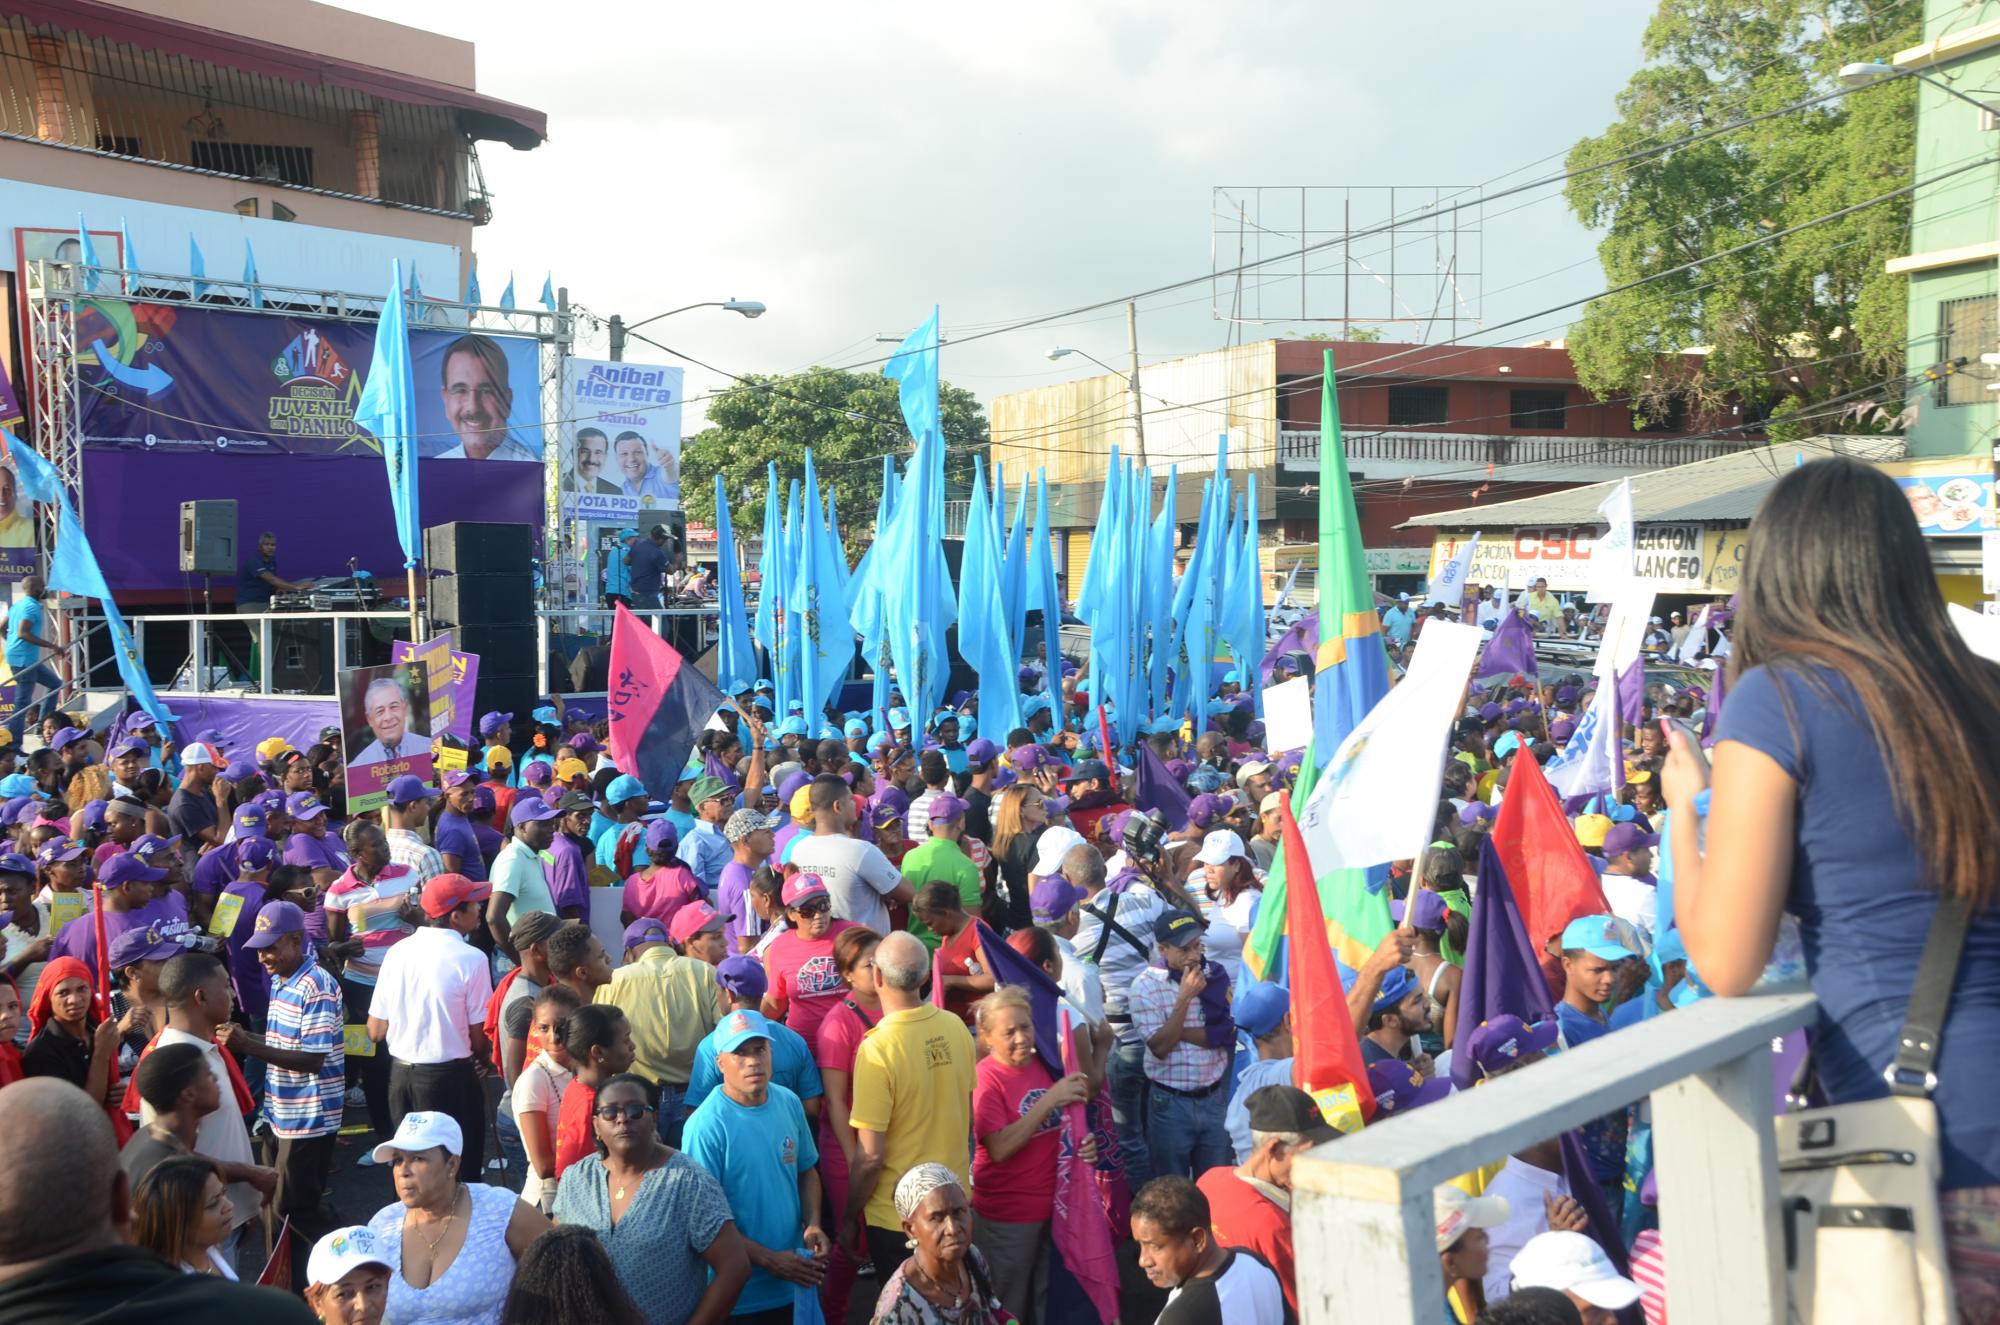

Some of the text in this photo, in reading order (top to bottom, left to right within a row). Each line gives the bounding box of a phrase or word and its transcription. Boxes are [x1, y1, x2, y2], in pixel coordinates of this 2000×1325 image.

[588, 365, 664, 387] Aníbal
[291, 386, 336, 398] DECISIÓN
[576, 380, 671, 403] Herrera
[269, 397, 353, 419] JUVENIL
[287, 416, 357, 436] DANILO
[596, 411, 647, 426] Danilo
[611, 498, 638, 509] PRD
[1515, 527, 1597, 560] CSC
[371, 761, 410, 778] Roberto
[349, 1231, 375, 1240] PRD
